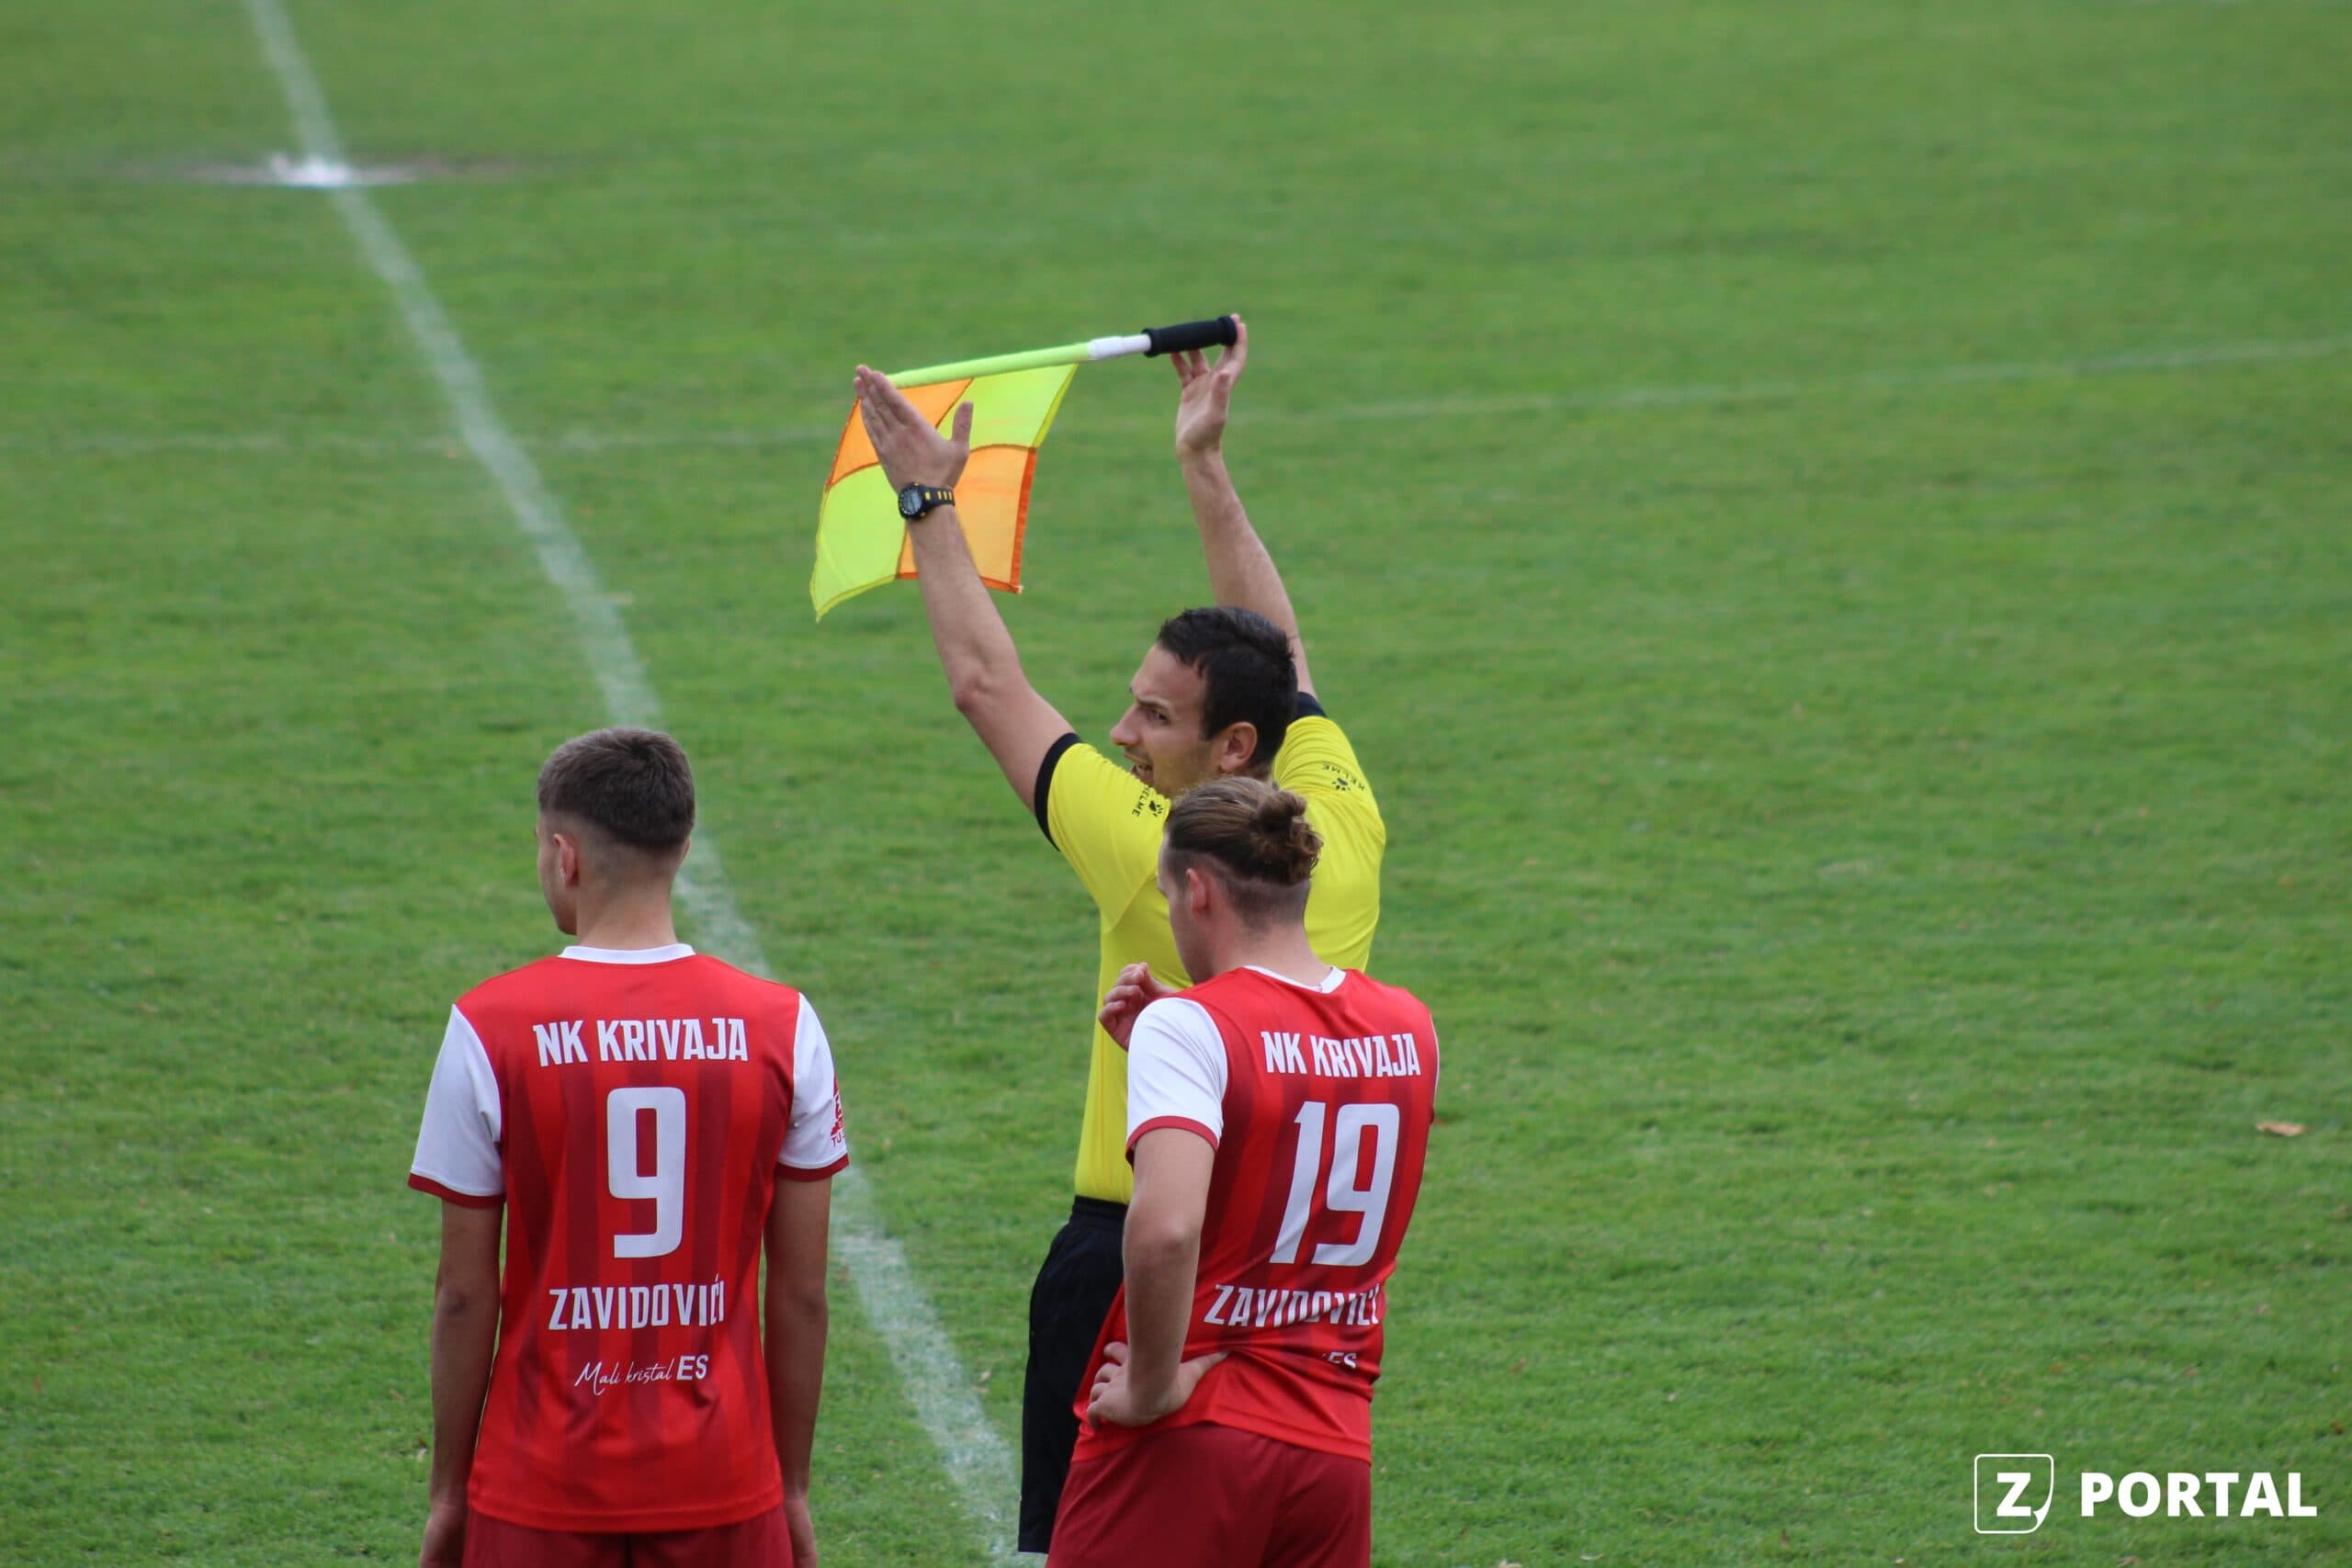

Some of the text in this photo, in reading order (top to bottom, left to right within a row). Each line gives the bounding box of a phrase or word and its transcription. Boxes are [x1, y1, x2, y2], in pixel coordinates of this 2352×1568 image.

[533, 1018, 749, 1066] NK KRIVAJA
[1261, 1031, 1421, 1078] NK KRIVAJA
[606, 1087, 686, 1258] 9
[1270, 1101, 1400, 1267] 19
[574, 1360, 620, 1395] Mali
[676, 1354, 709, 1381] ES
